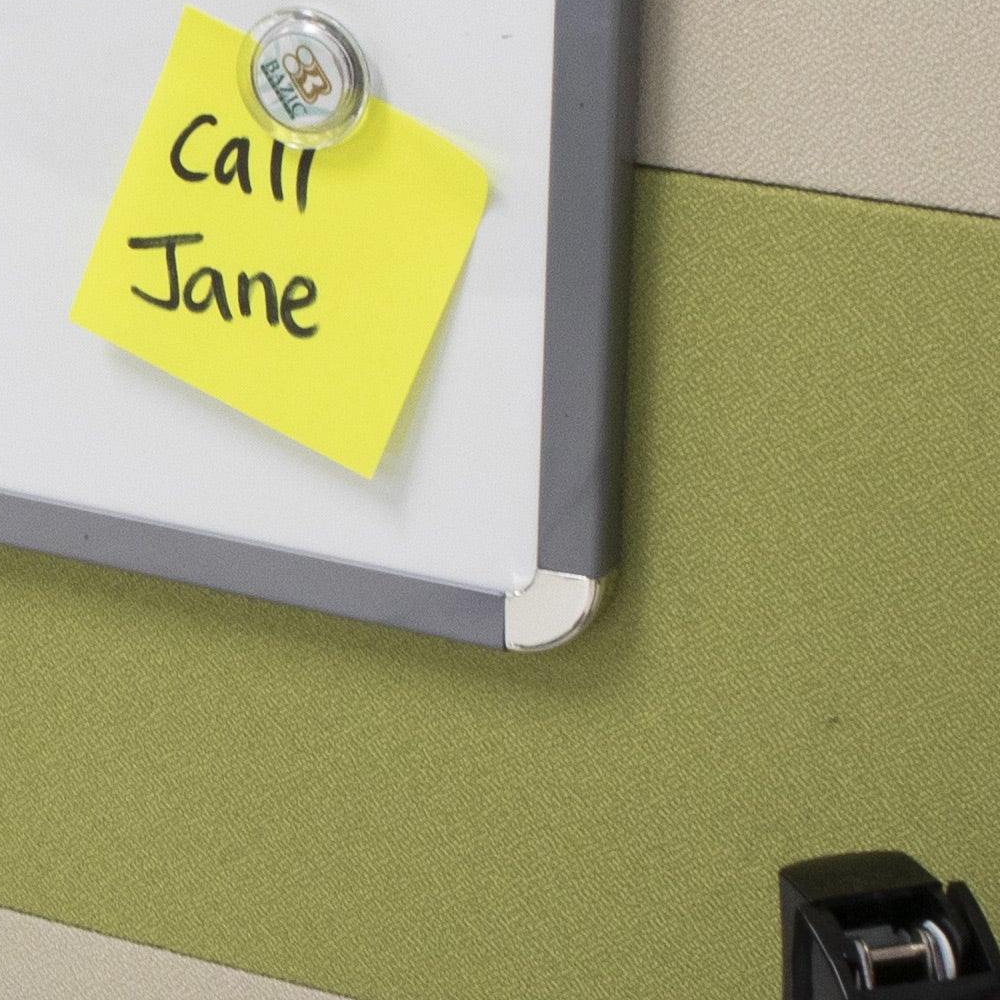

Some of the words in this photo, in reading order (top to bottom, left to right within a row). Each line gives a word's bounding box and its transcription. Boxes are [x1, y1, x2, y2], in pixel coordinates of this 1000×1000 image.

[261, 58, 309, 120] BAZIC
[170, 114, 316, 214] Call
[128, 233, 318, 338] Jane
